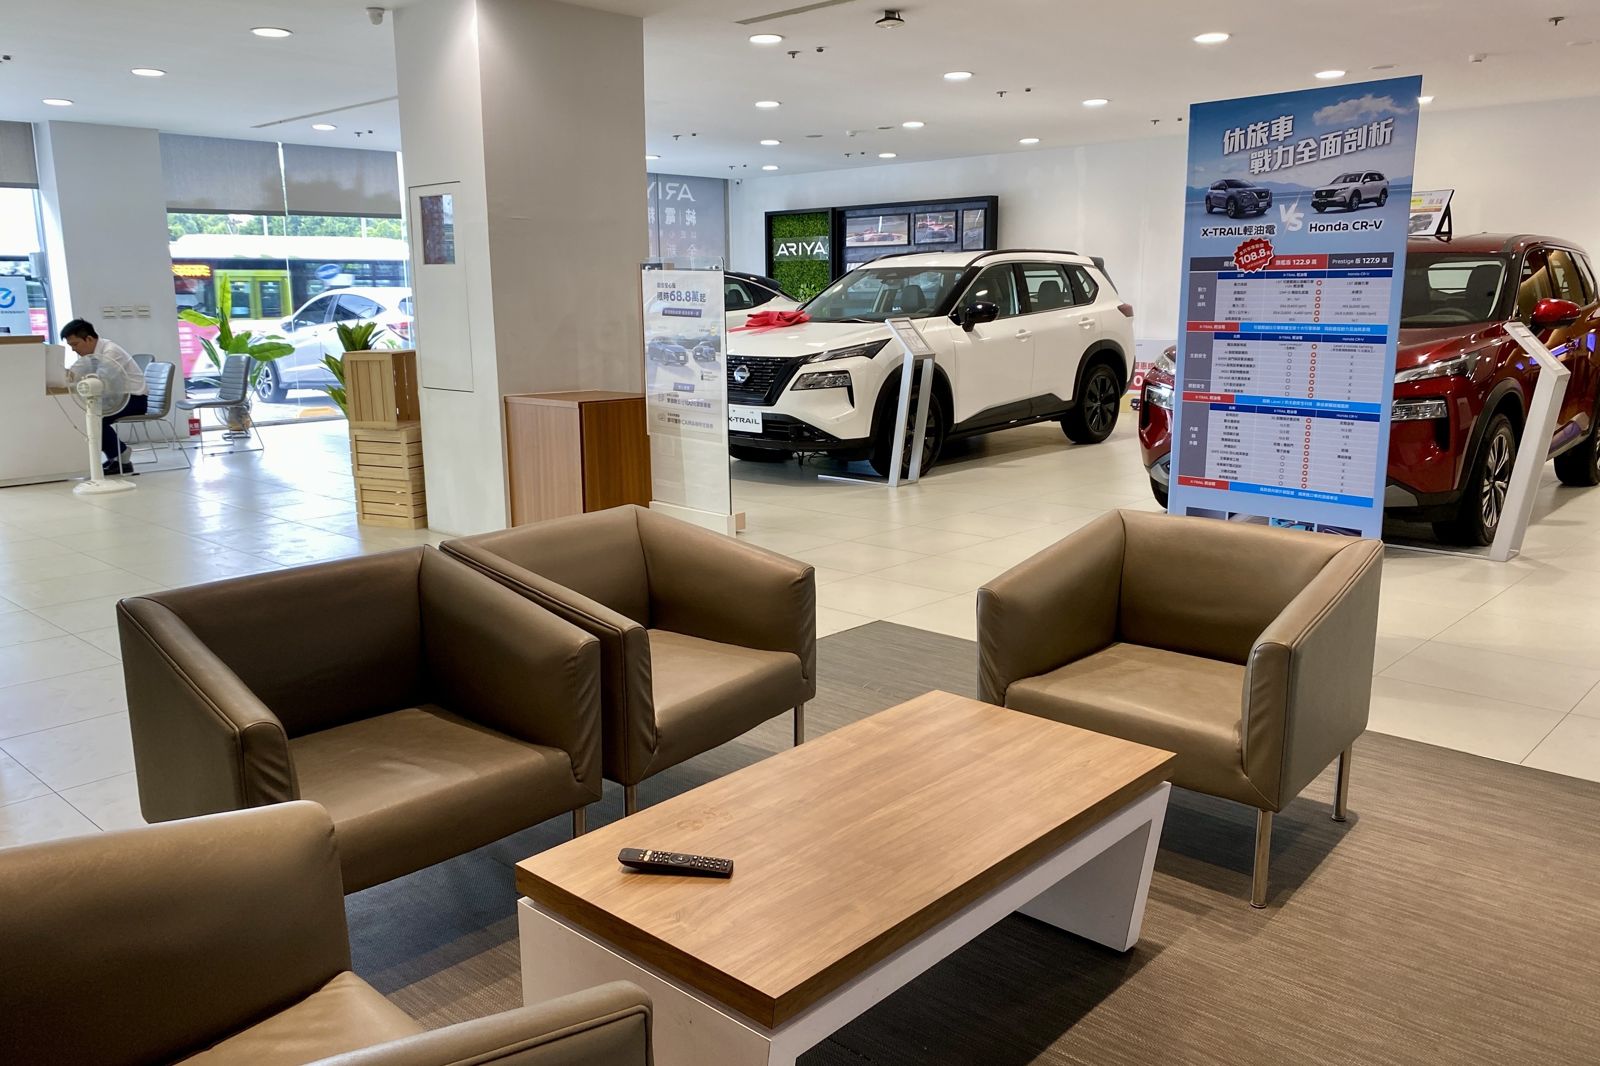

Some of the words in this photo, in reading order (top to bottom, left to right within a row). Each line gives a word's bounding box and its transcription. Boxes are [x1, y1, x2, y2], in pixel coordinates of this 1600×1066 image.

[1223, 115, 1294, 154] 休旅車
[1250, 118, 1394, 174] 戰力全面剖析
[1279, 202, 1304, 231] VS
[1309, 221, 1349, 233] Honda
[1351, 220, 1383, 231] CR-V
[775, 241, 828, 256] ARIYA
